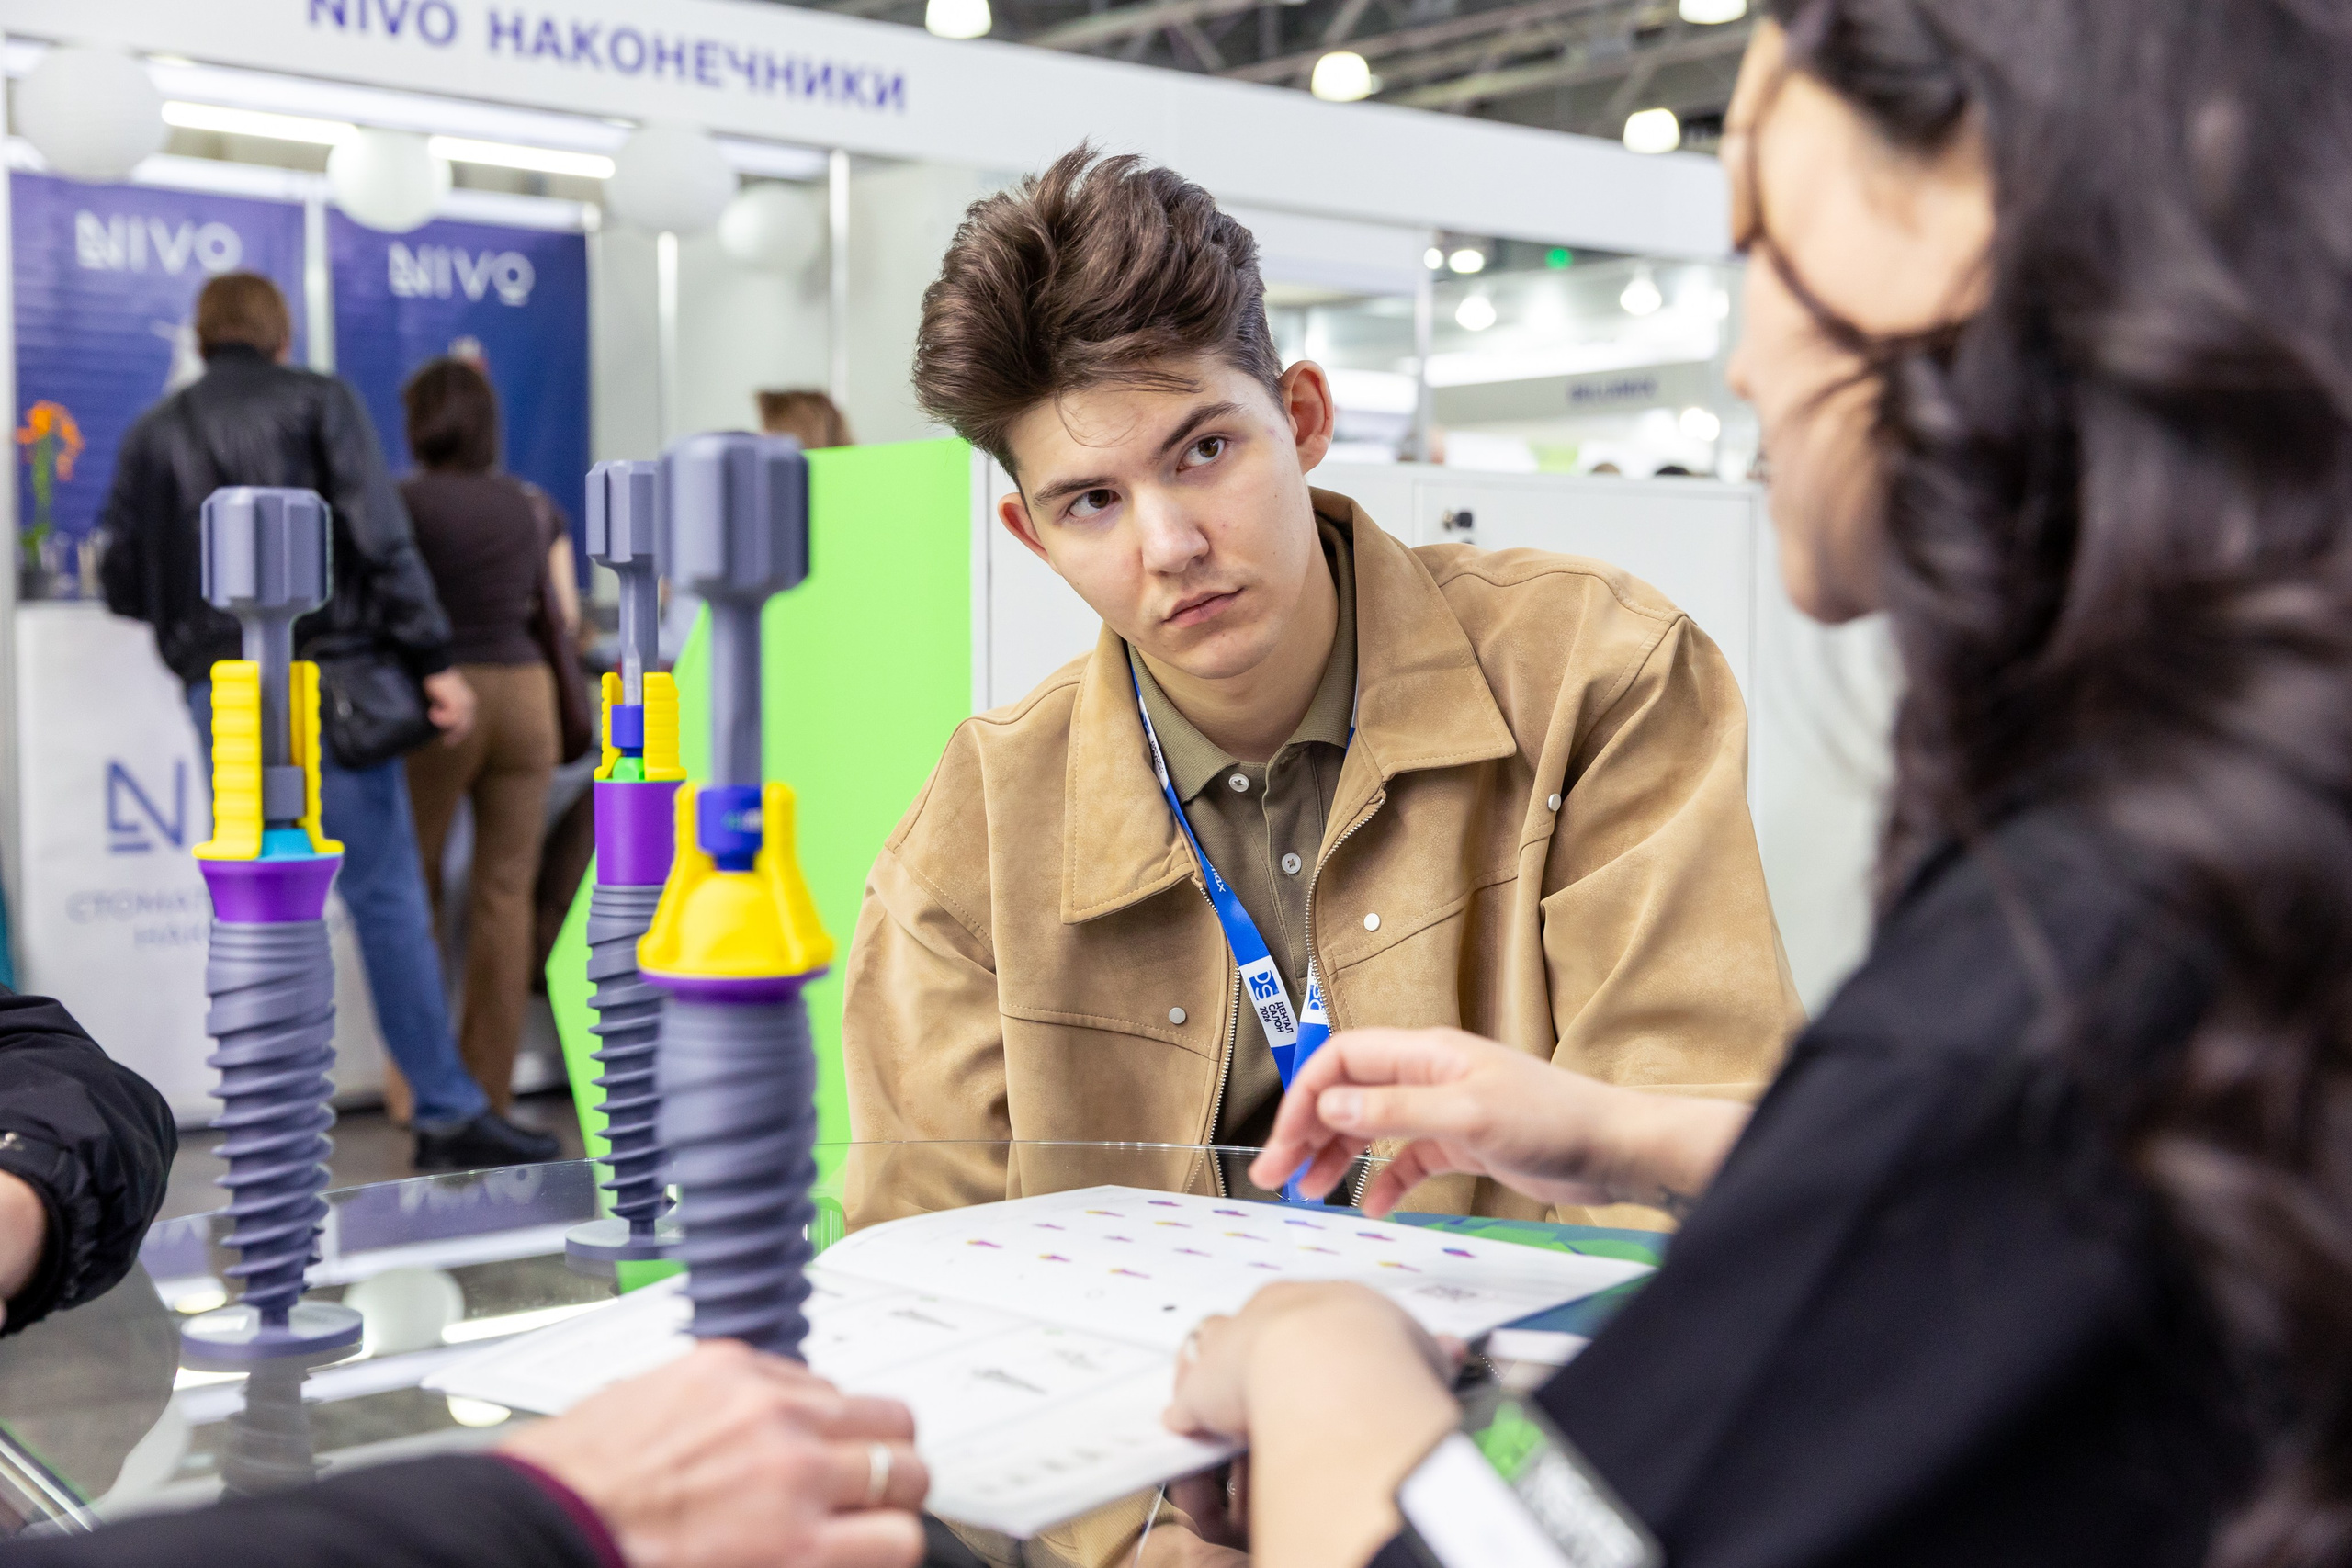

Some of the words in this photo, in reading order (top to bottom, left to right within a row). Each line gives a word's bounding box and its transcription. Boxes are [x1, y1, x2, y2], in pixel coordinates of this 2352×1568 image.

[307, 0, 458, 48] NIVO
[487, 10, 907, 111] НАКОНЕЧНИКИ
[75, 209, 243, 274] NIVO
[388, 241, 536, 306] NIVO
[1260, 1006, 1272, 1023] 2026
[1268, 1003, 1284, 1032] САЛОН
[1275, 1001, 1294, 1033] ДЕНТАЛ
